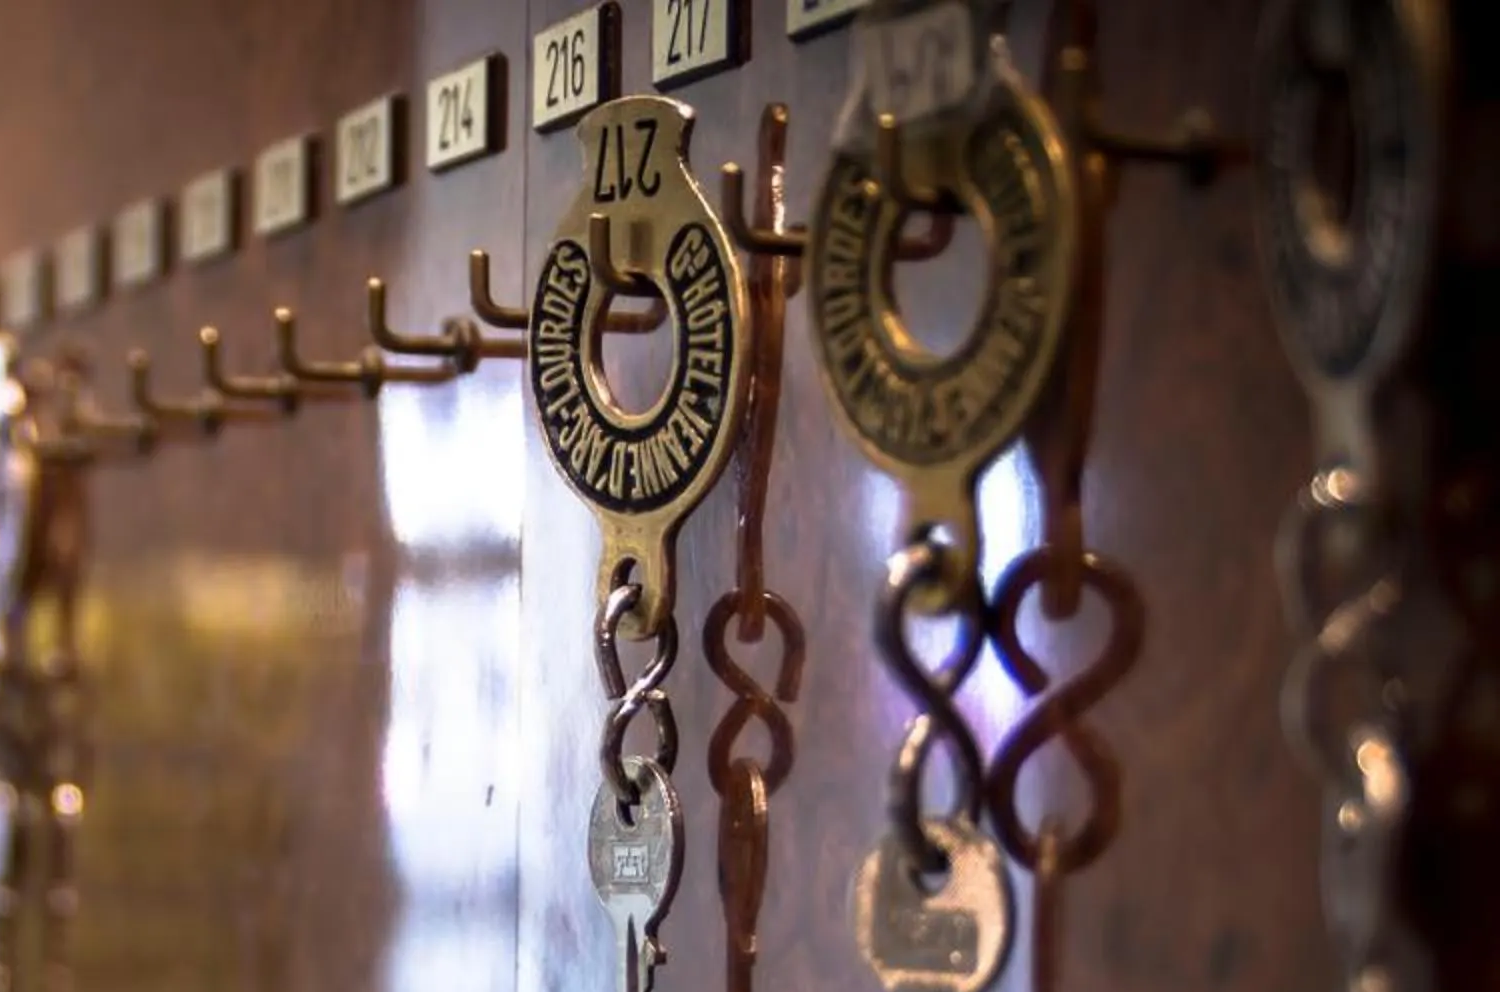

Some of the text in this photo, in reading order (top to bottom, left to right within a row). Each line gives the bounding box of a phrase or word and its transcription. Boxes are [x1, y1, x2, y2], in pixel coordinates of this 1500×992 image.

[546, 30, 586, 107] 216
[667, 0, 710, 65] 217
[438, 77, 474, 150] 214
[594, 119, 661, 203] 217
